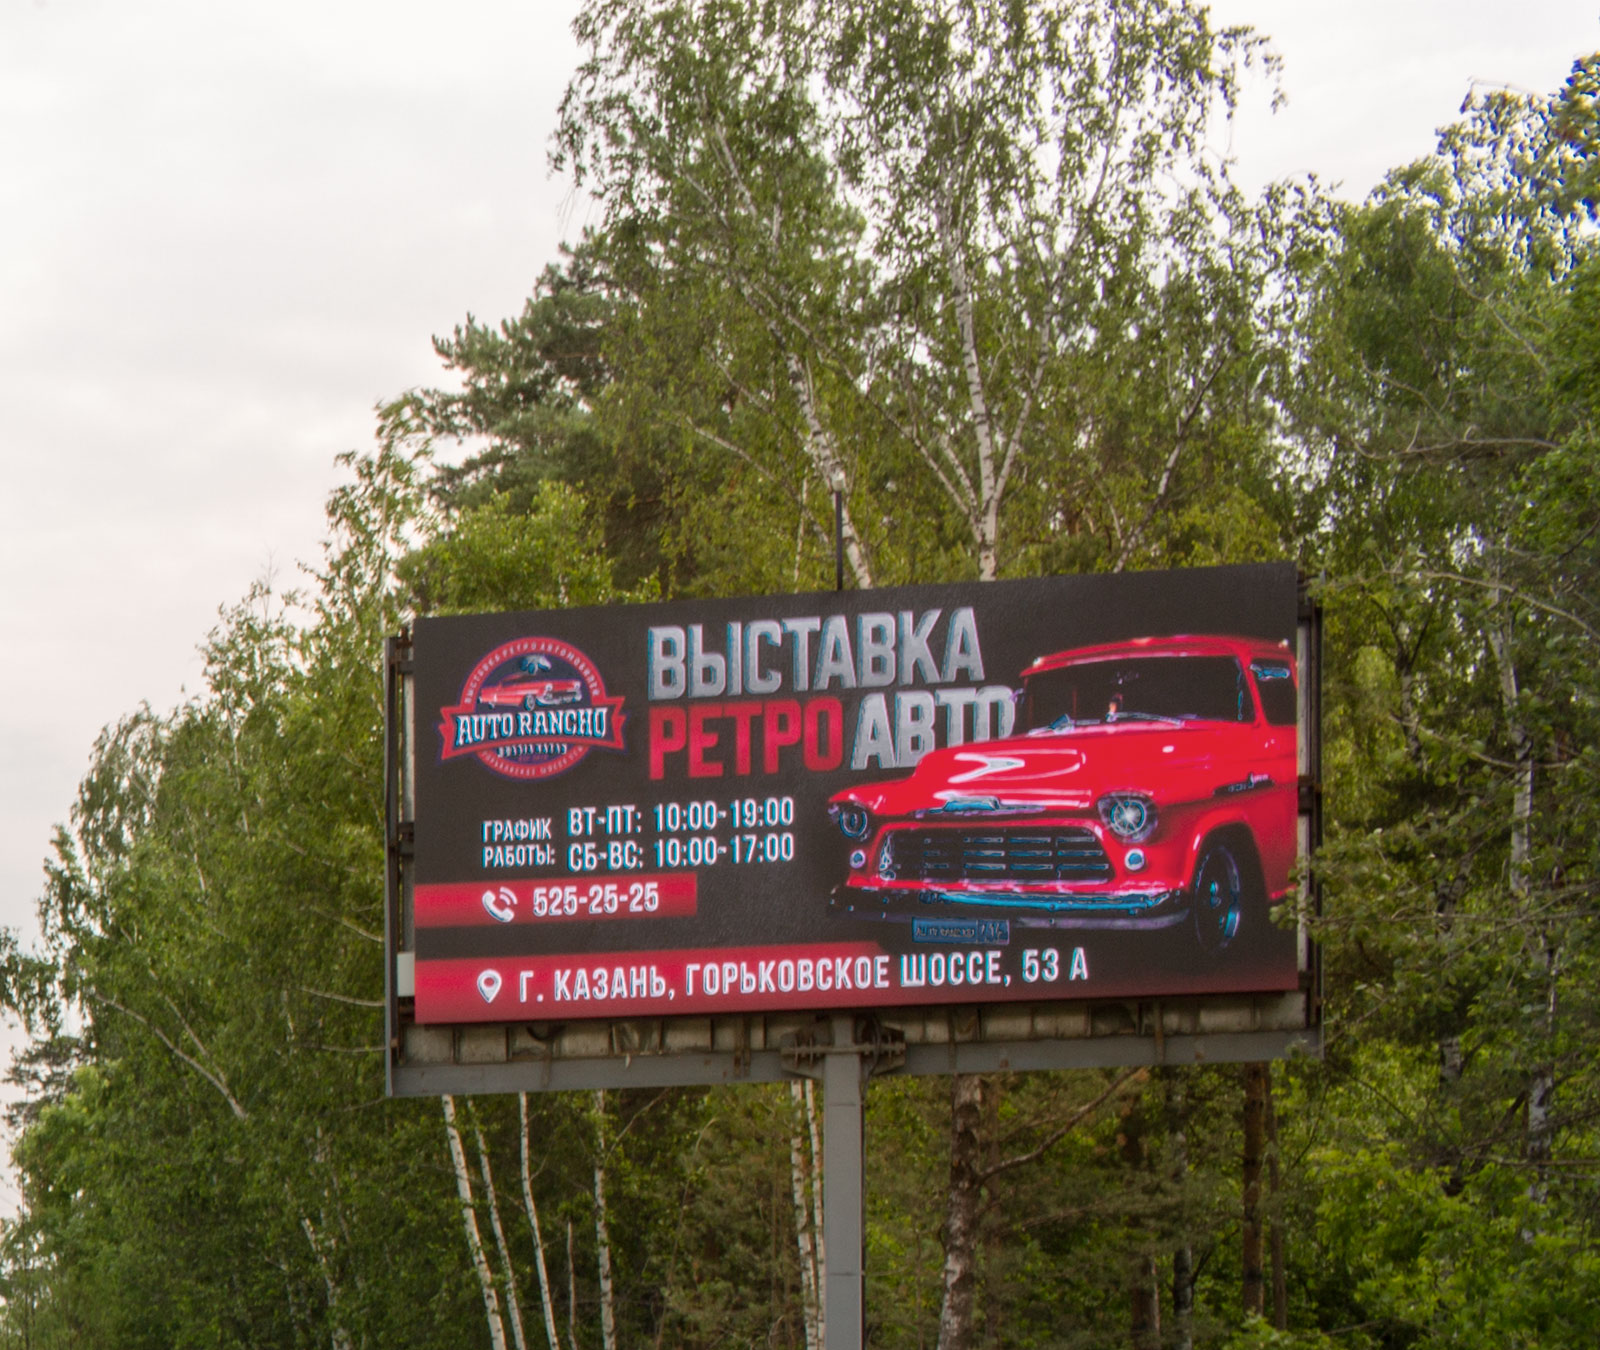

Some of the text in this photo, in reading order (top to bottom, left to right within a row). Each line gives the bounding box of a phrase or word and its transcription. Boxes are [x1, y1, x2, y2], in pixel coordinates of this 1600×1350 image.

[648, 606, 985, 700] ВЫСТАВКА
[455, 708, 607, 747] AUTO RANCHO
[648, 685, 1015, 780] РЕТРО АВТО
[482, 818, 552, 843] ГРАФИК
[567, 796, 794, 837] ВТ-ПТ: 10:00-19:00
[482, 844, 556, 868] РАБОТЫ:
[567, 832, 794, 872] СБ-ВС: 10:00-17:00
[532, 881, 660, 917] 525-25-25
[519, 946, 1090, 1003] Г. КАЗАНЬ, ГОРЬКОВСКОЕ ШОССЕ, 53 А
